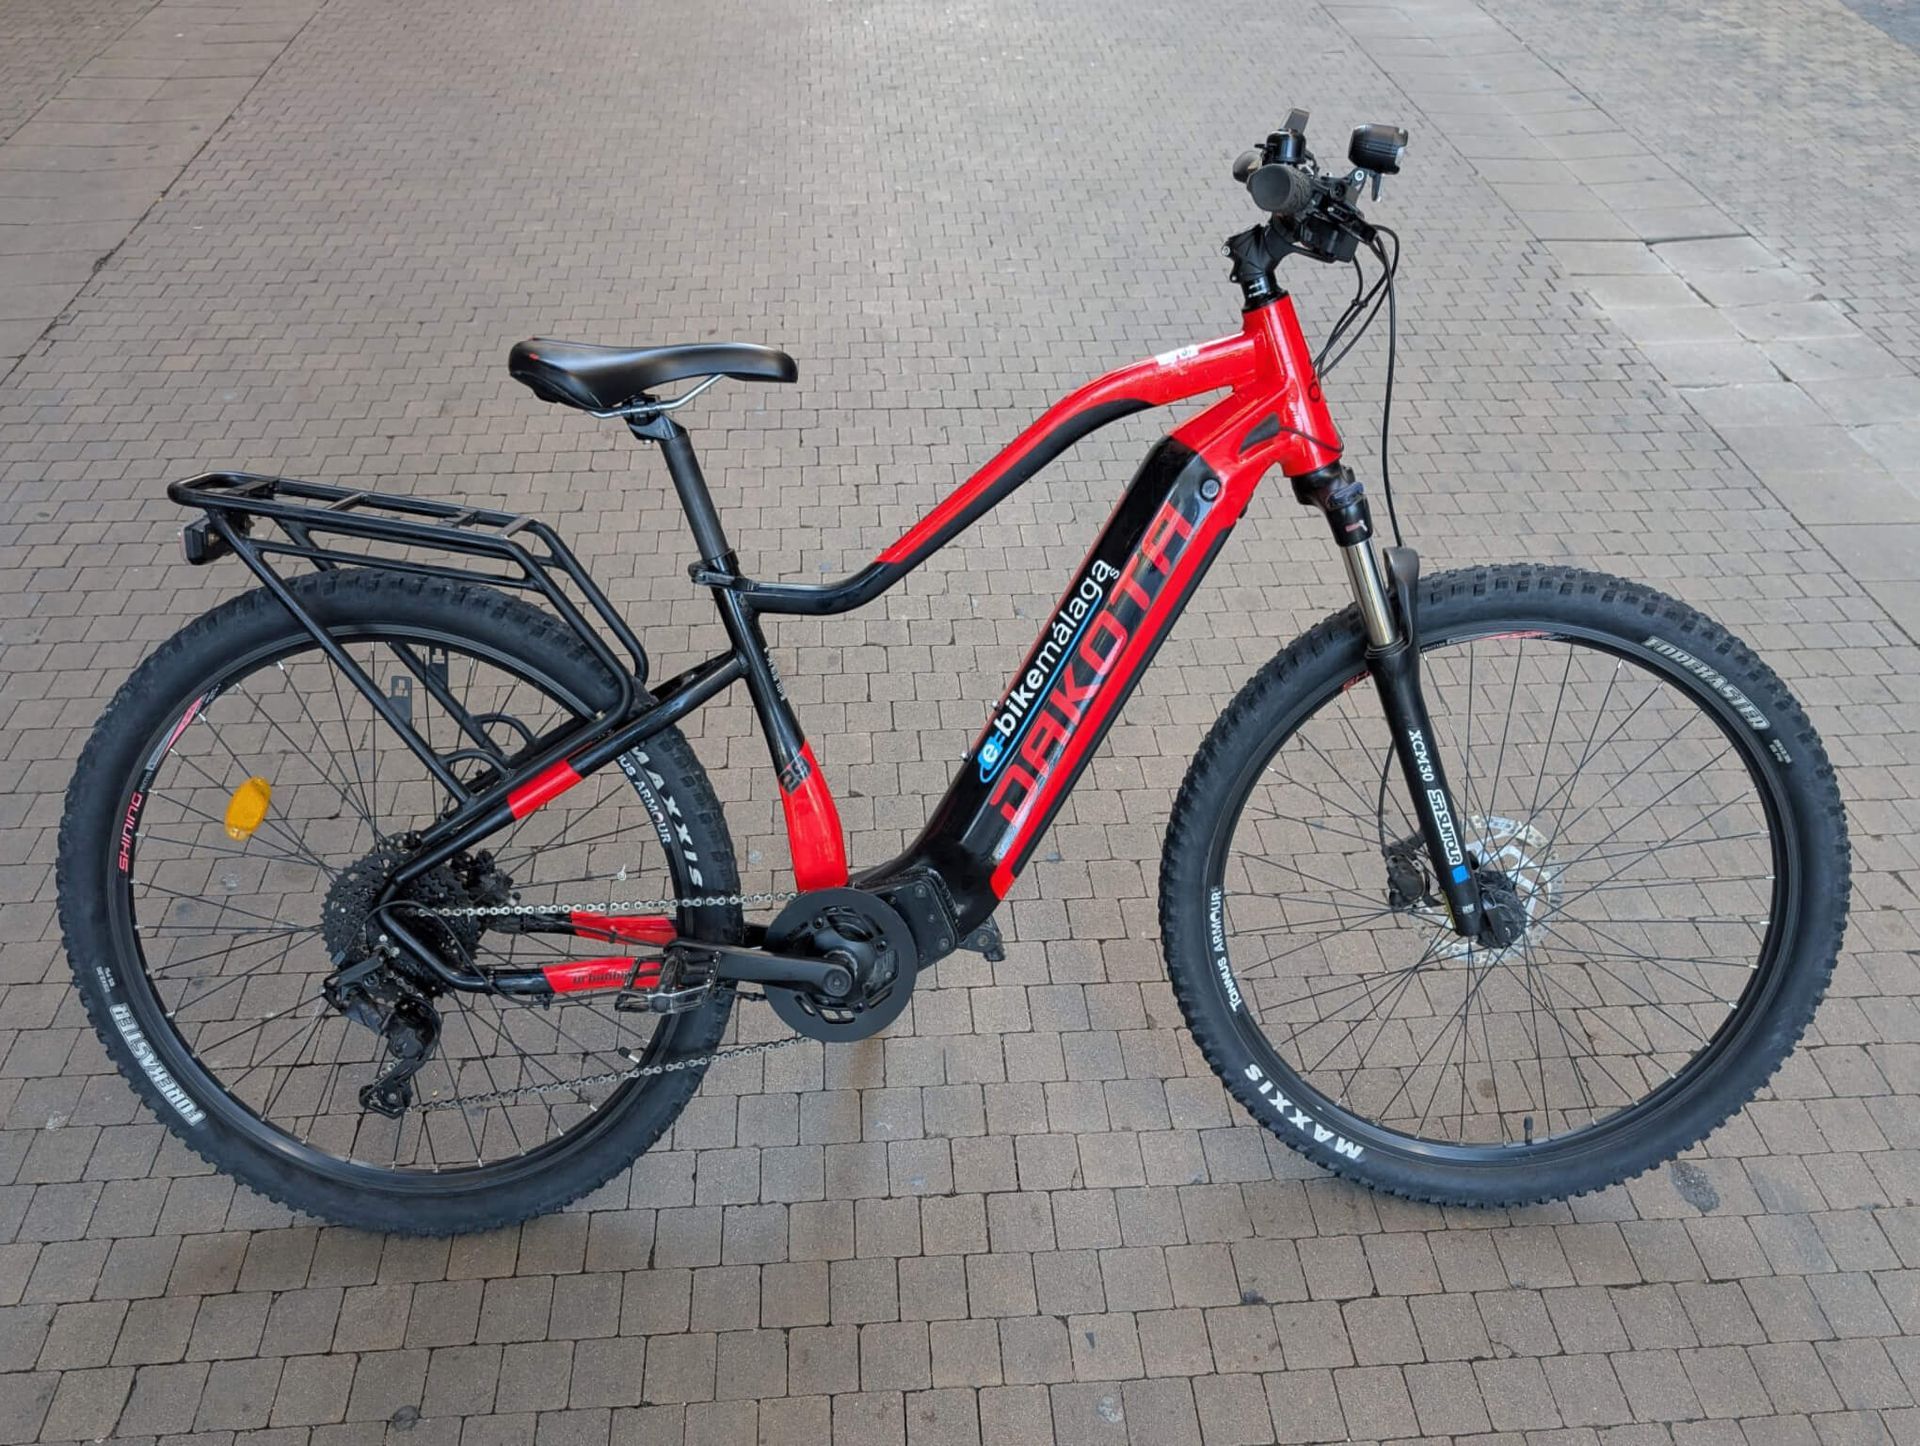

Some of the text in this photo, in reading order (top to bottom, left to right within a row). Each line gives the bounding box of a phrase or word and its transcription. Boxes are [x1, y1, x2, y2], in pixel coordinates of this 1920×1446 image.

[990, 503, 1192, 826] DAKOTA
[1642, 636, 1770, 729] FOREKASTER
[1408, 730, 1434, 782] XCM30
[119, 791, 142, 872] SHINING
[634, 781, 671, 844] ARMOUR
[1209, 890, 1224, 952] ARMOUR
[110, 1002, 207, 1127] FOREKASTER
[1244, 1063, 1364, 1160] MAXXIS
